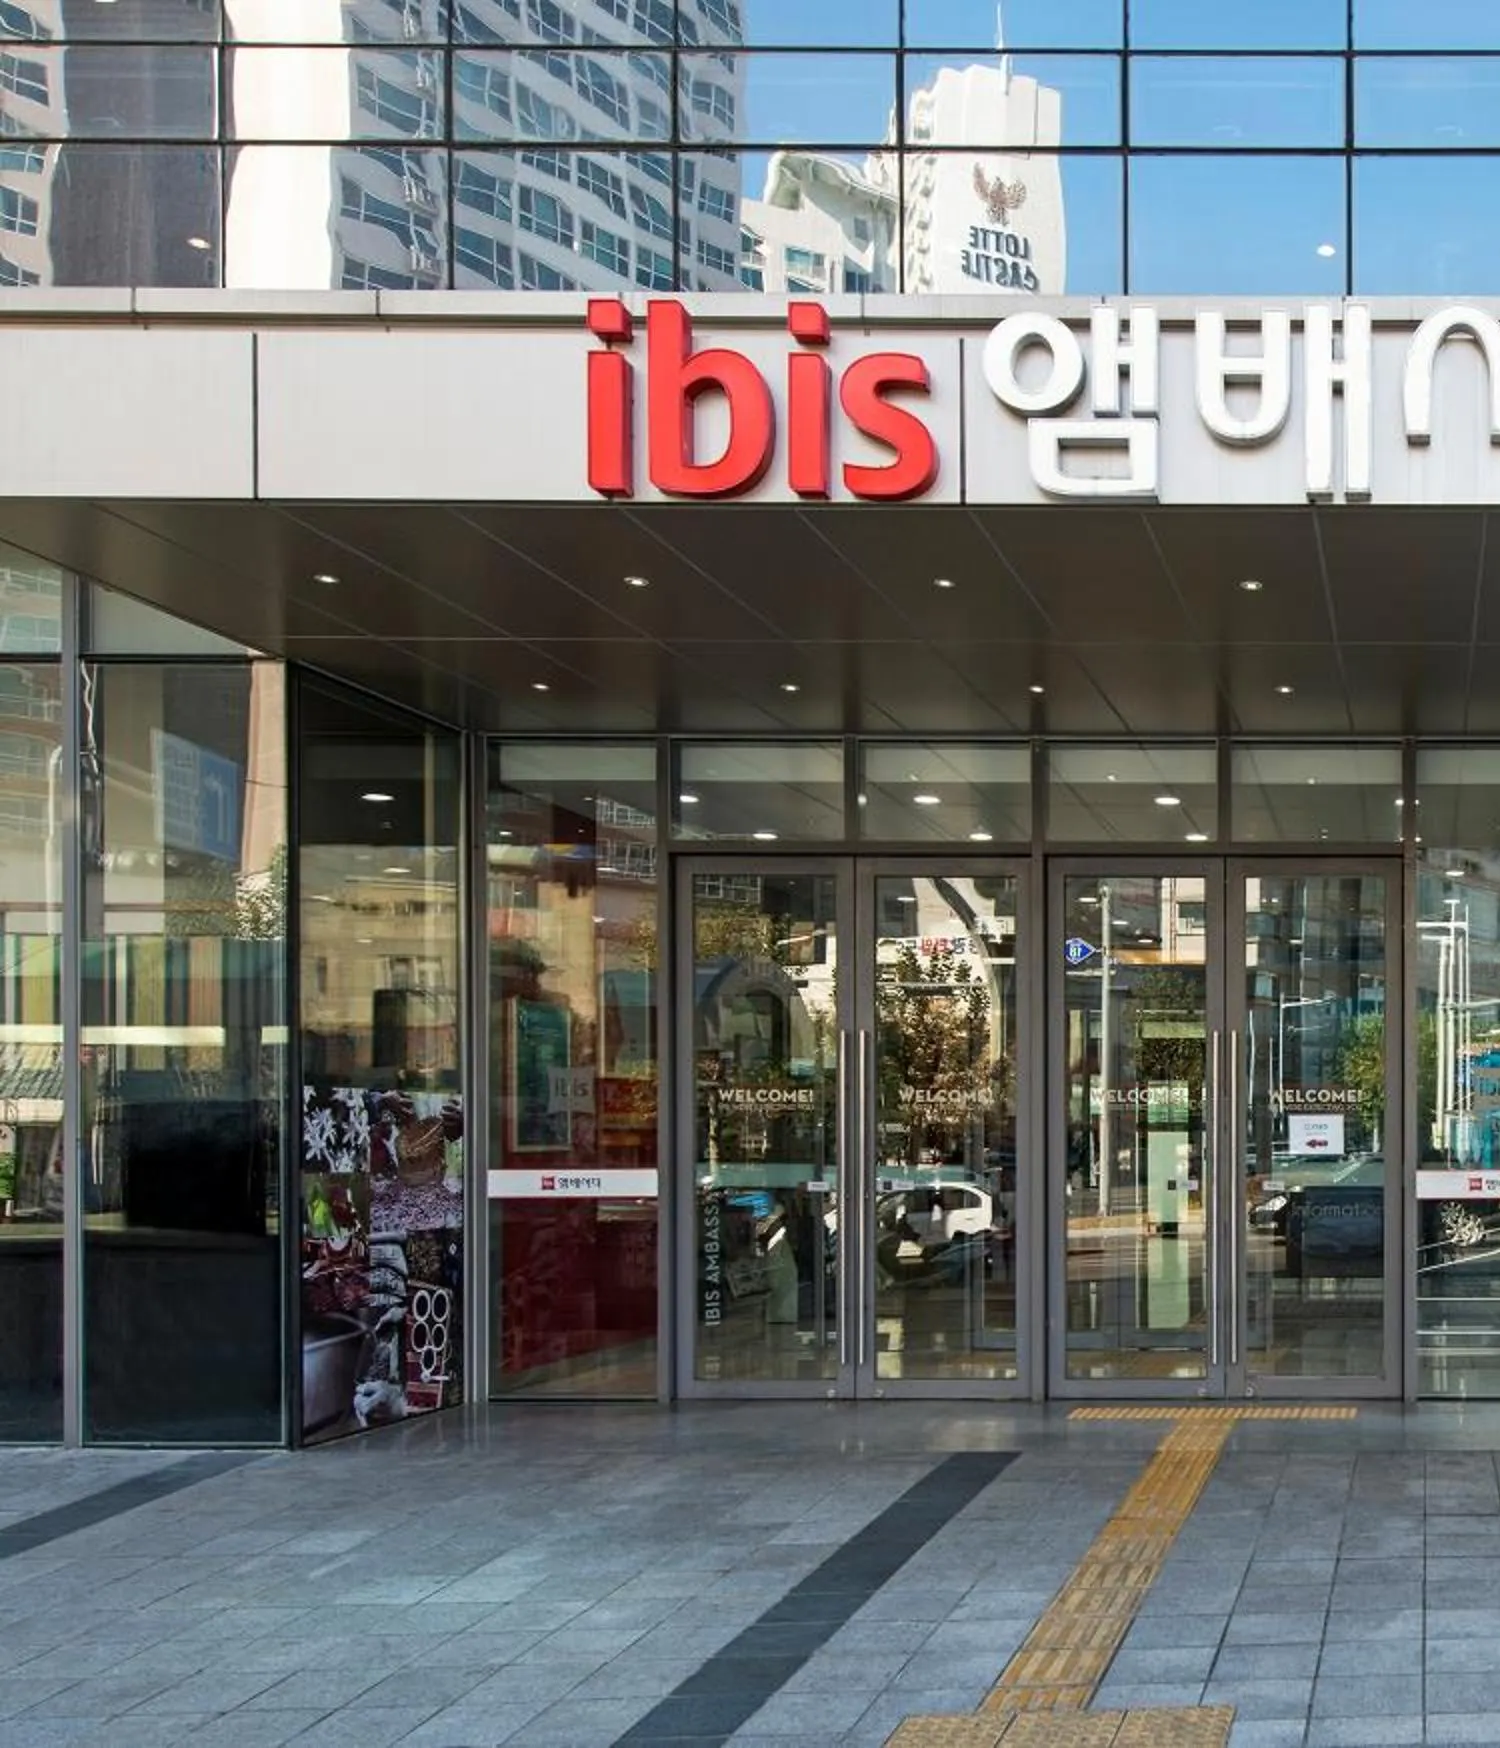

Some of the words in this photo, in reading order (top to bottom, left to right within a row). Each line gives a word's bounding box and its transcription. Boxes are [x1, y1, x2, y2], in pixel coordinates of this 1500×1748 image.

[587, 299, 938, 501] ibis
[719, 1088, 814, 1103] WELCOME!
[704, 1290, 721, 1326] IBIS
